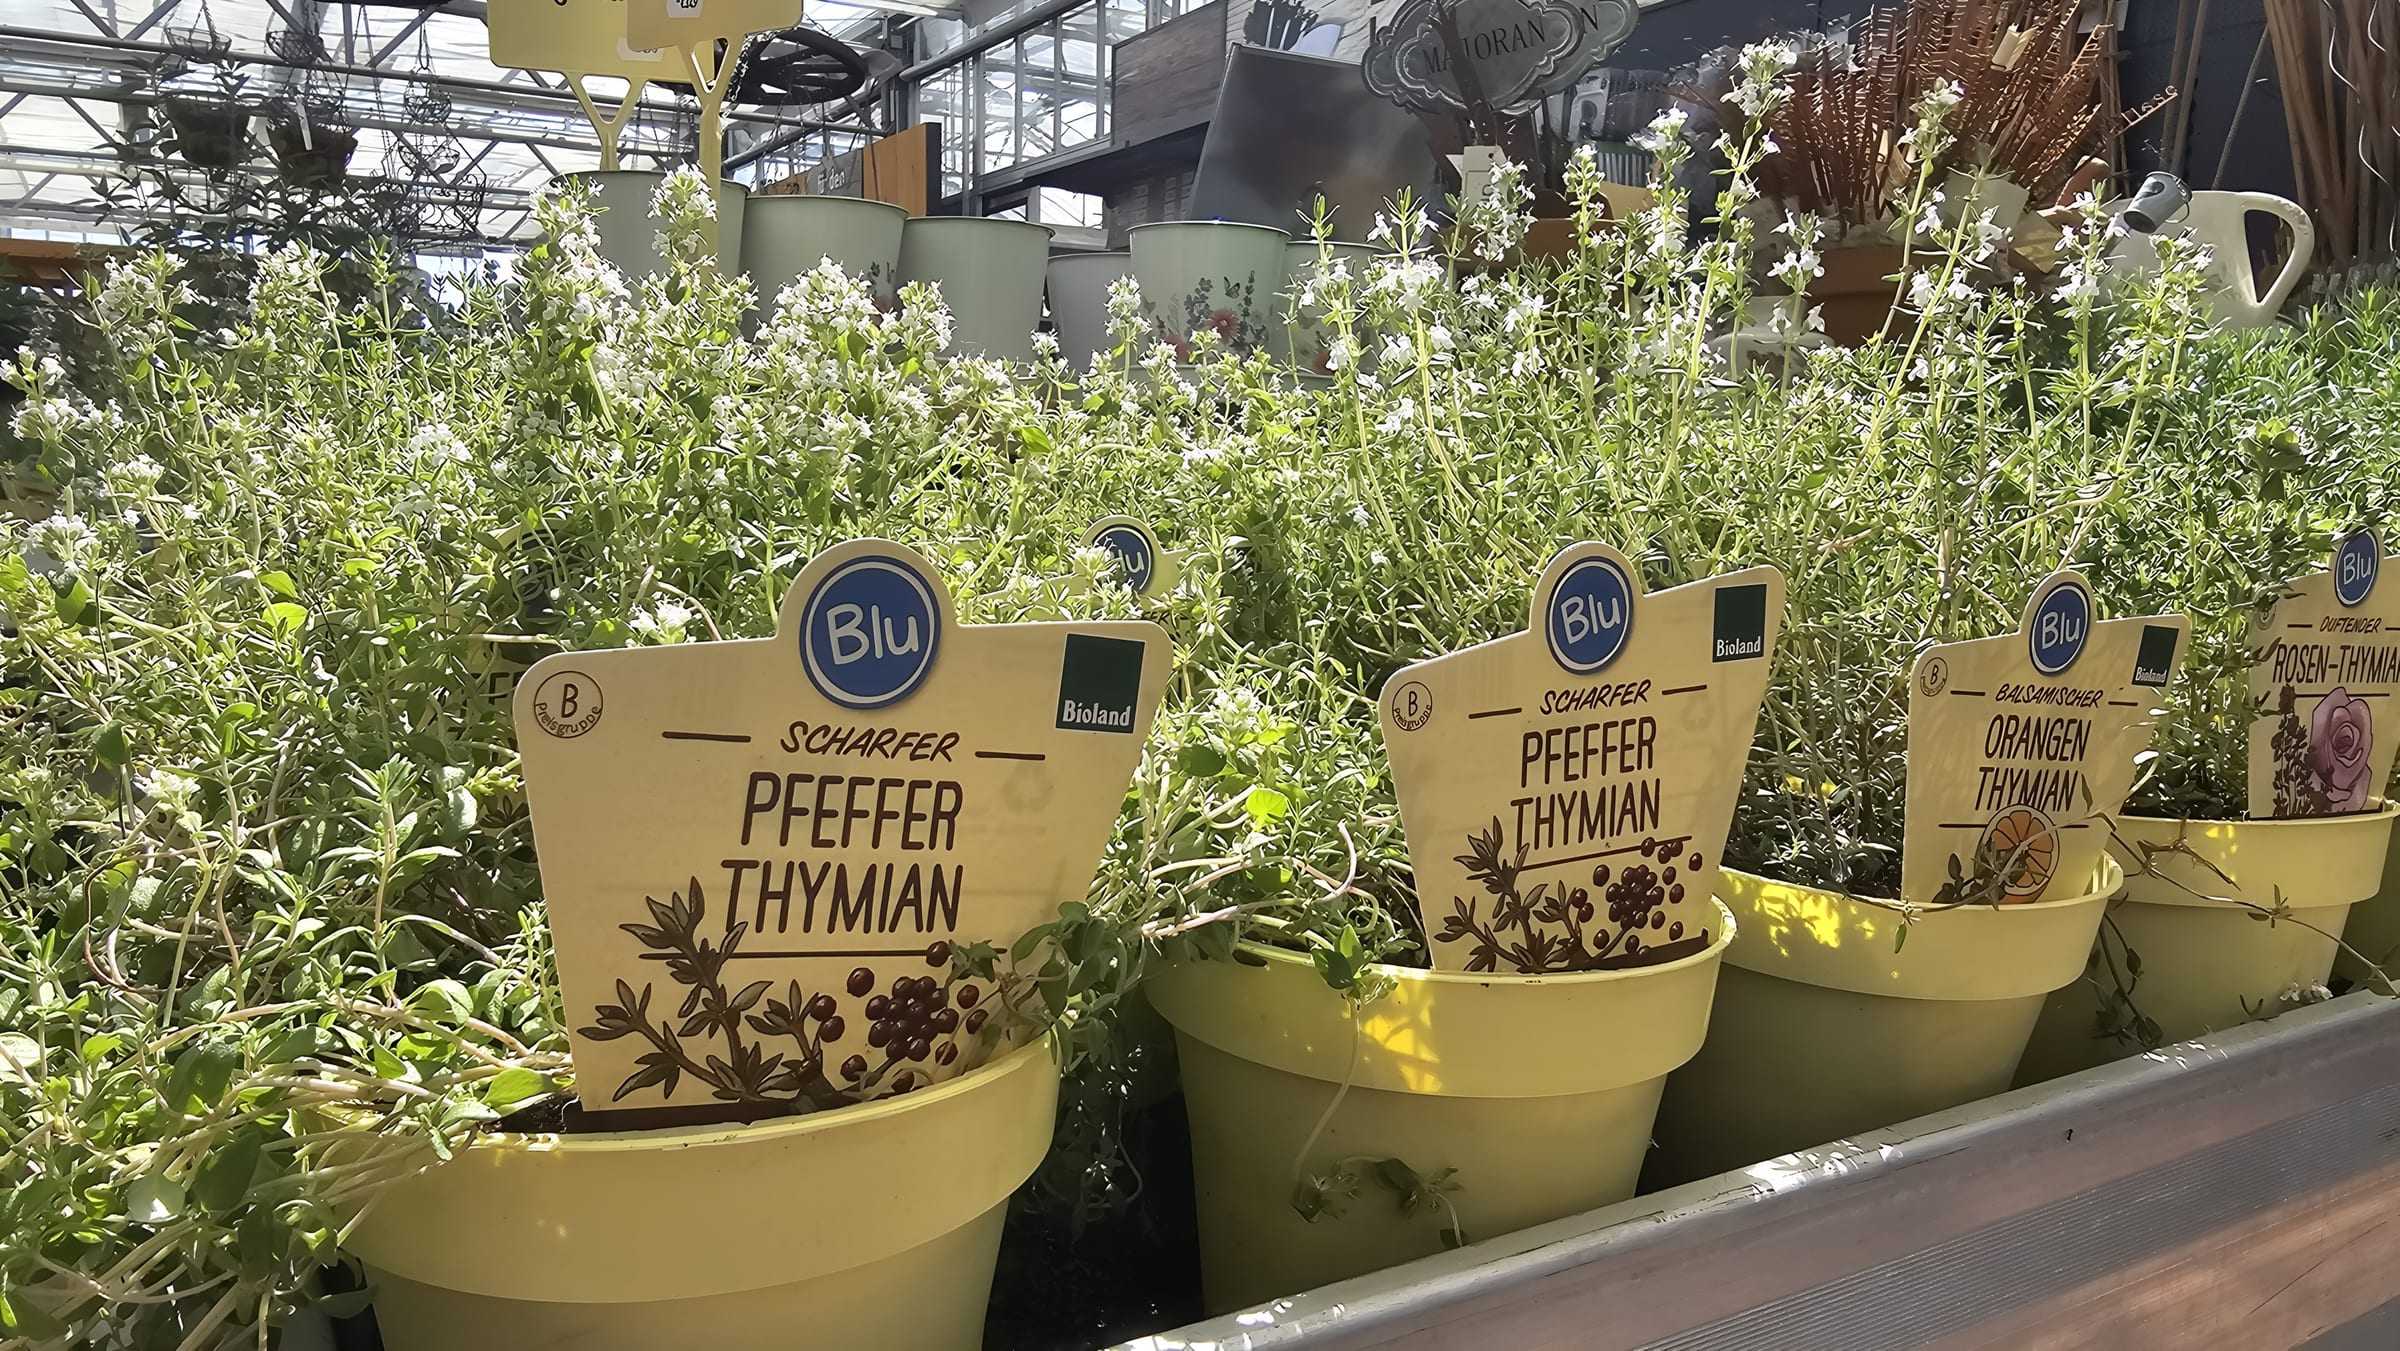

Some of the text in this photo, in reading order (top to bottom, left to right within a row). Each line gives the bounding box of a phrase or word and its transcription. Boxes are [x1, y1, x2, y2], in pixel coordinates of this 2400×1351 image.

[2342, 551, 2372, 585] Blu
[826, 603, 919, 665] Blu
[1560, 593, 1622, 645] Blu
[2041, 611, 2080, 650] Blu
[2319, 616, 2383, 634] DUFTENDER
[1715, 635, 1762, 658] Bioland
[1931, 664, 1940, 686] B
[561, 683, 579, 719] B
[1061, 699, 1132, 727] Bioland
[1408, 690, 1418, 718] B
[1539, 679, 1652, 715] SCHARFER
[1994, 683, 2104, 709] BALSAMISCHER
[780, 720, 961, 763] SCHARFER
[1520, 715, 1657, 788] PFEFFER
[1984, 713, 2093, 762] ORANGEN
[1974, 766, 2080, 813] THYMIAN
[740, 771, 964, 851] PFEFFER
[1510, 777, 1661, 852] THYMIAN
[720, 859, 964, 935] THYMIAN
